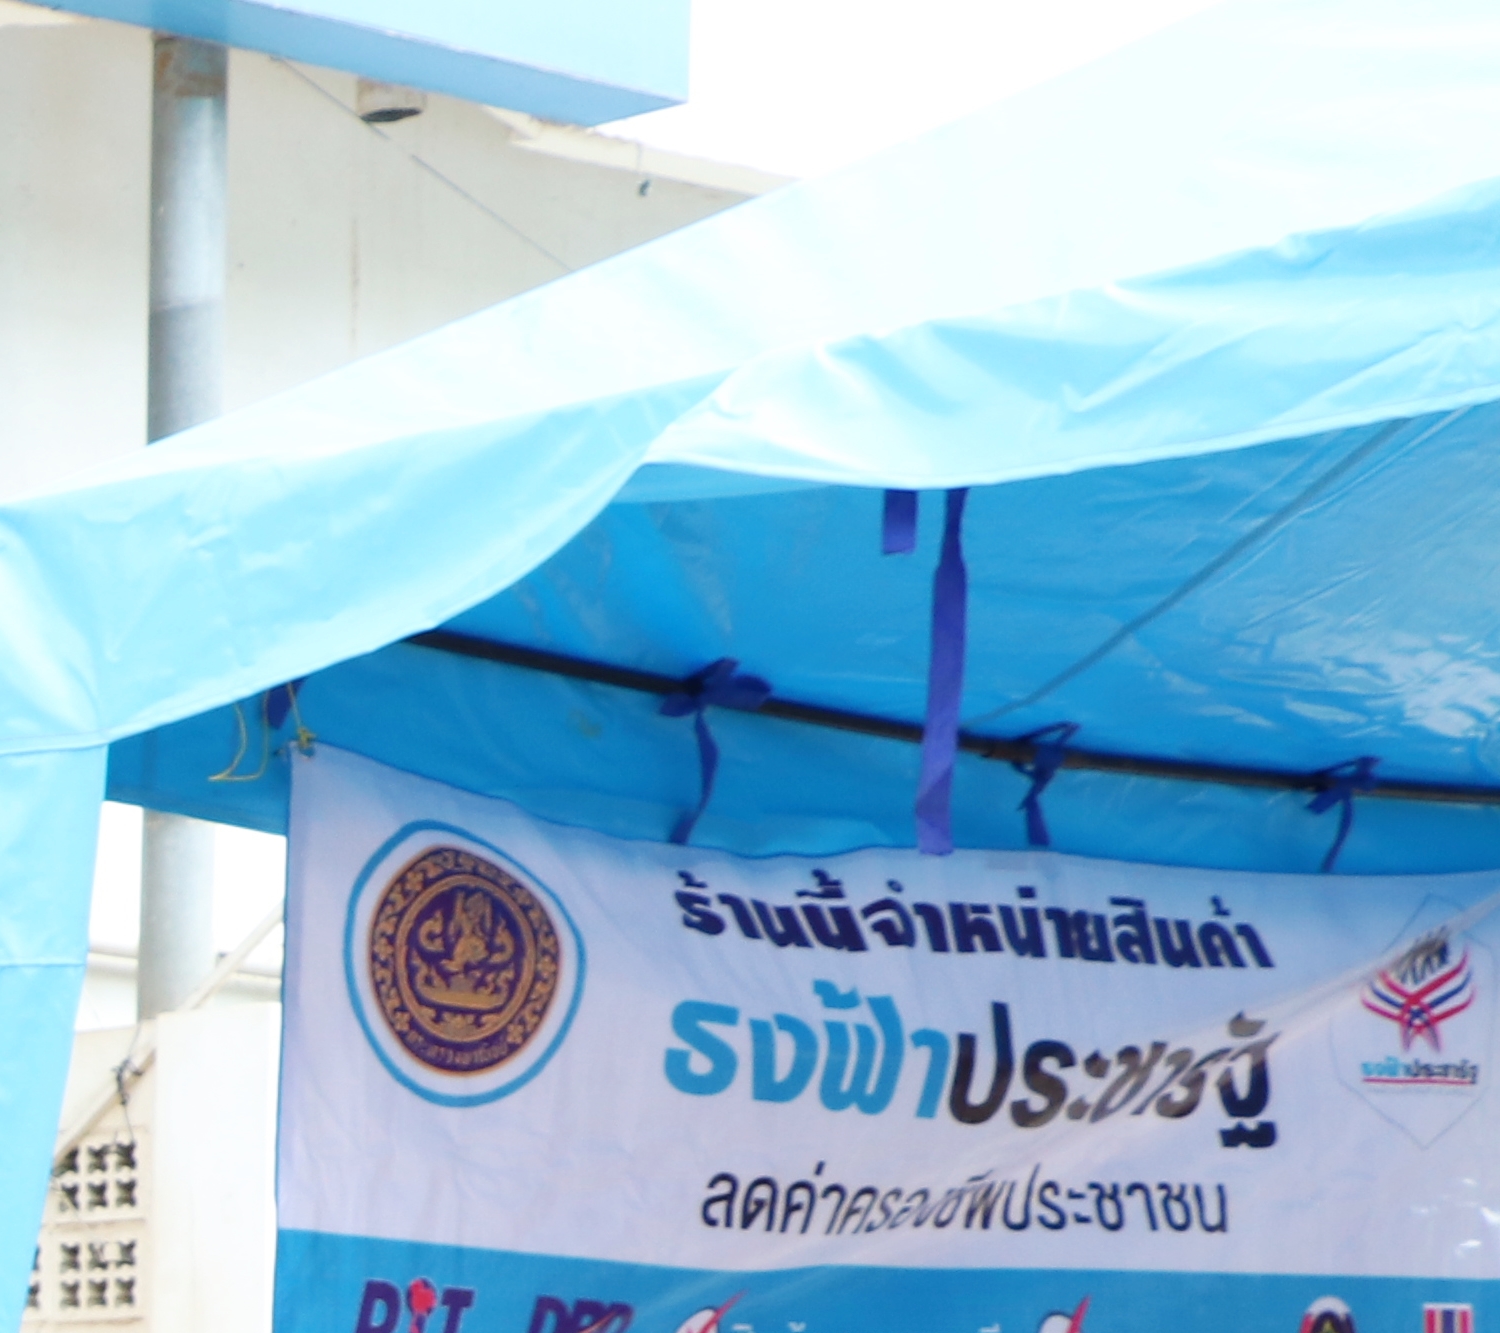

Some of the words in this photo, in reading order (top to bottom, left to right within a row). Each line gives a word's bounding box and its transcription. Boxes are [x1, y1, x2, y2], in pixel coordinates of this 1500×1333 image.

[676, 870, 1275, 972] ร้านนี้จำหน่ายสินค้า
[663, 978, 1280, 1147] ธงฟ้าประชารัฐ
[700, 1161, 1230, 1235] ลดค่าครองชีพประชาชน
